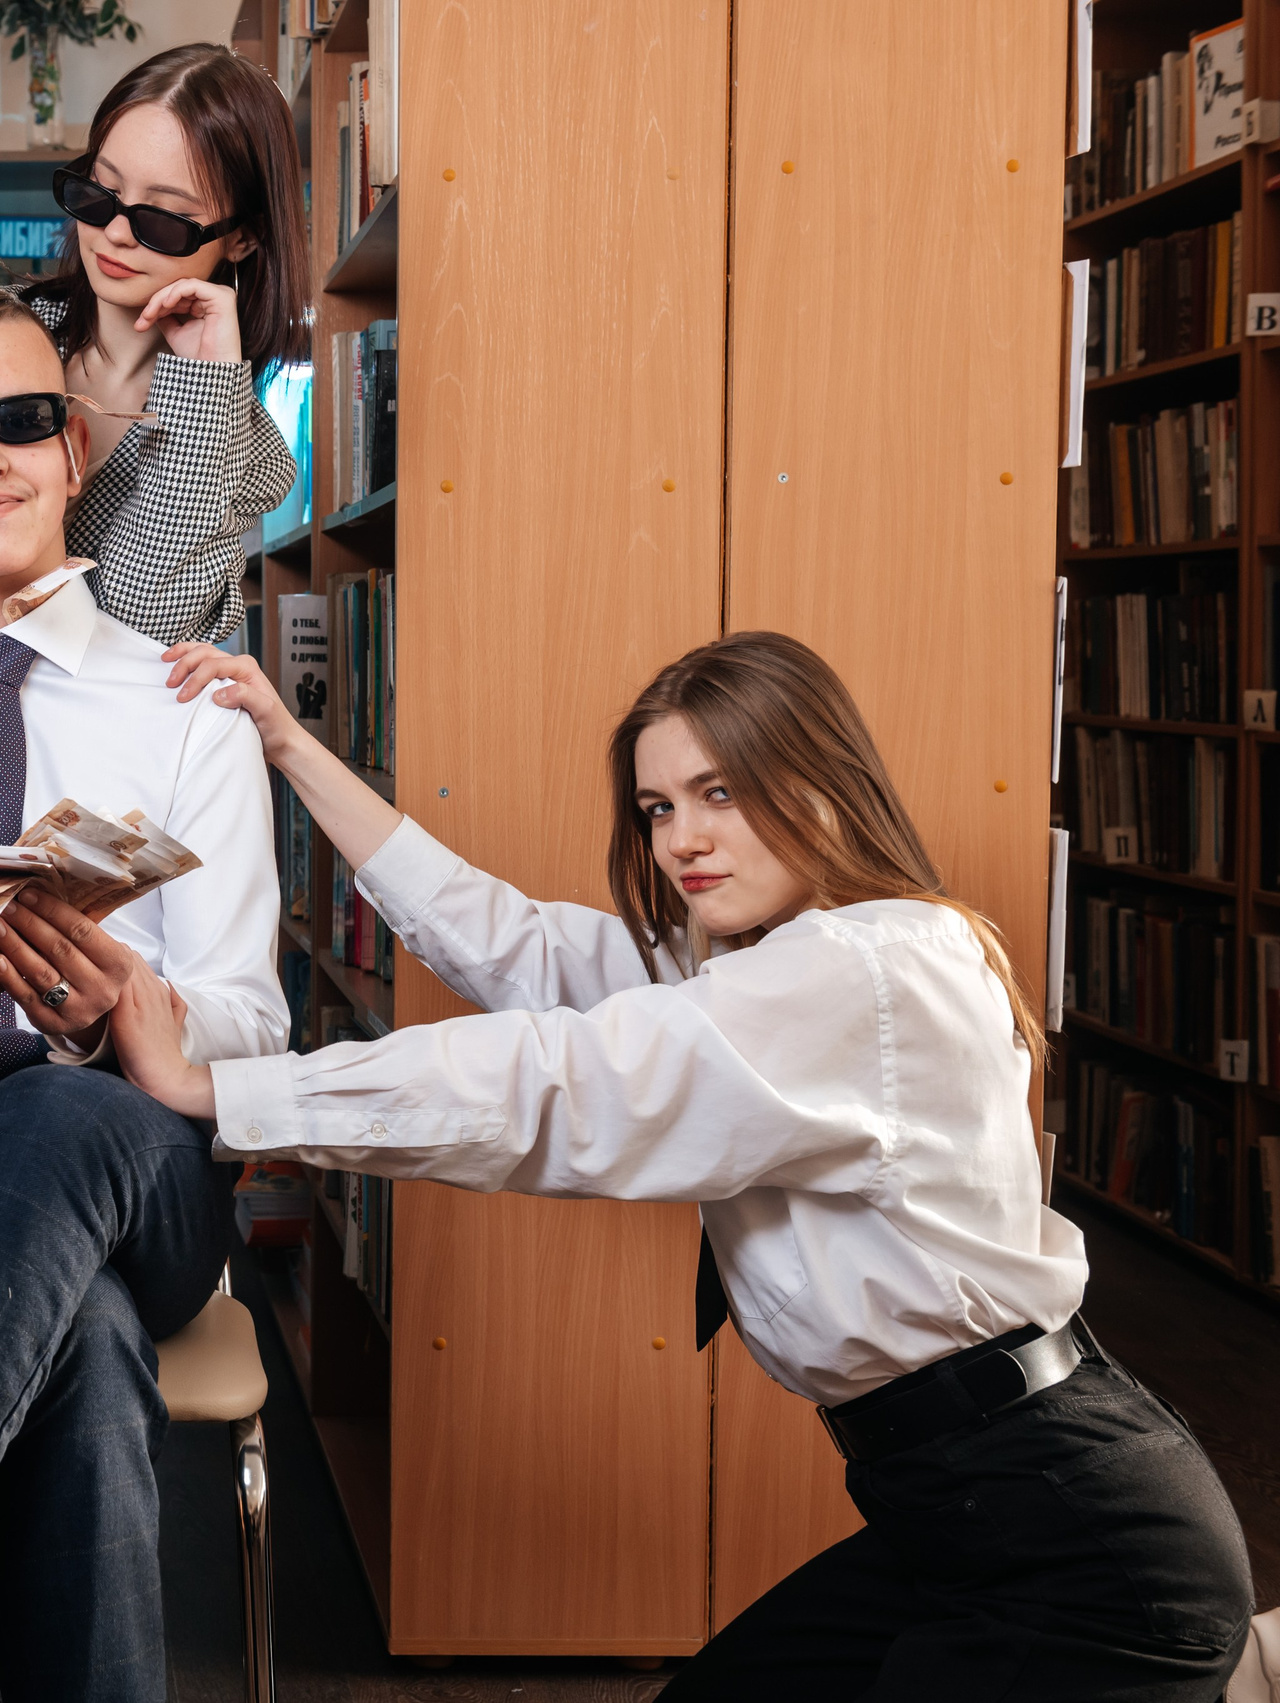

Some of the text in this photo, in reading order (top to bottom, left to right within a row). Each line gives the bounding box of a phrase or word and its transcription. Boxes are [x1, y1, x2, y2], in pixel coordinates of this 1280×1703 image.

[1255, 305, 1279, 332] В
[291, 618, 321, 629] О ТЕБЕ,
[291, 635, 298, 645] О
[291, 652, 297, 662] О
